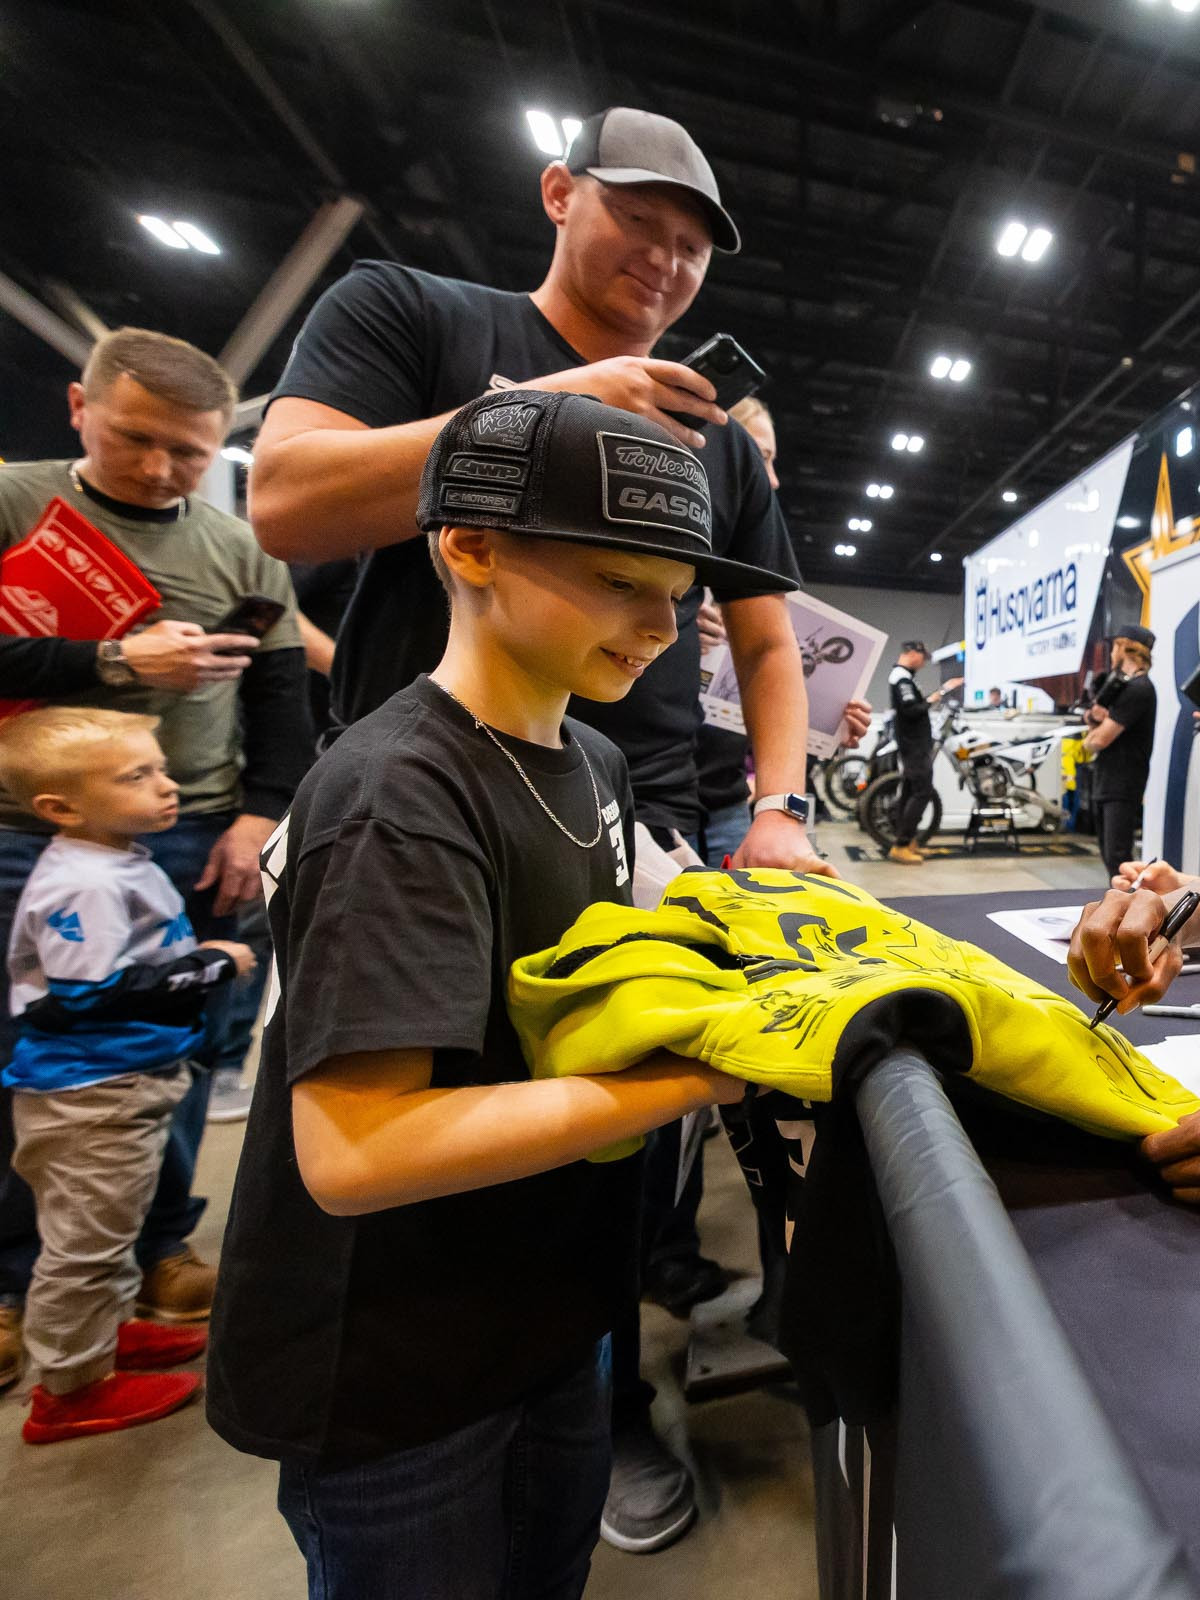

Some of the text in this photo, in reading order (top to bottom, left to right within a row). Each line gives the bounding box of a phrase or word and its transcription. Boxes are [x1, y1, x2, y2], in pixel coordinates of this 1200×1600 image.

[616, 446, 658, 475] Troy
[656, 452, 685, 477] Lee
[461, 493, 509, 507] MOTOREX
[989, 562, 1077, 638] Husqvarna
